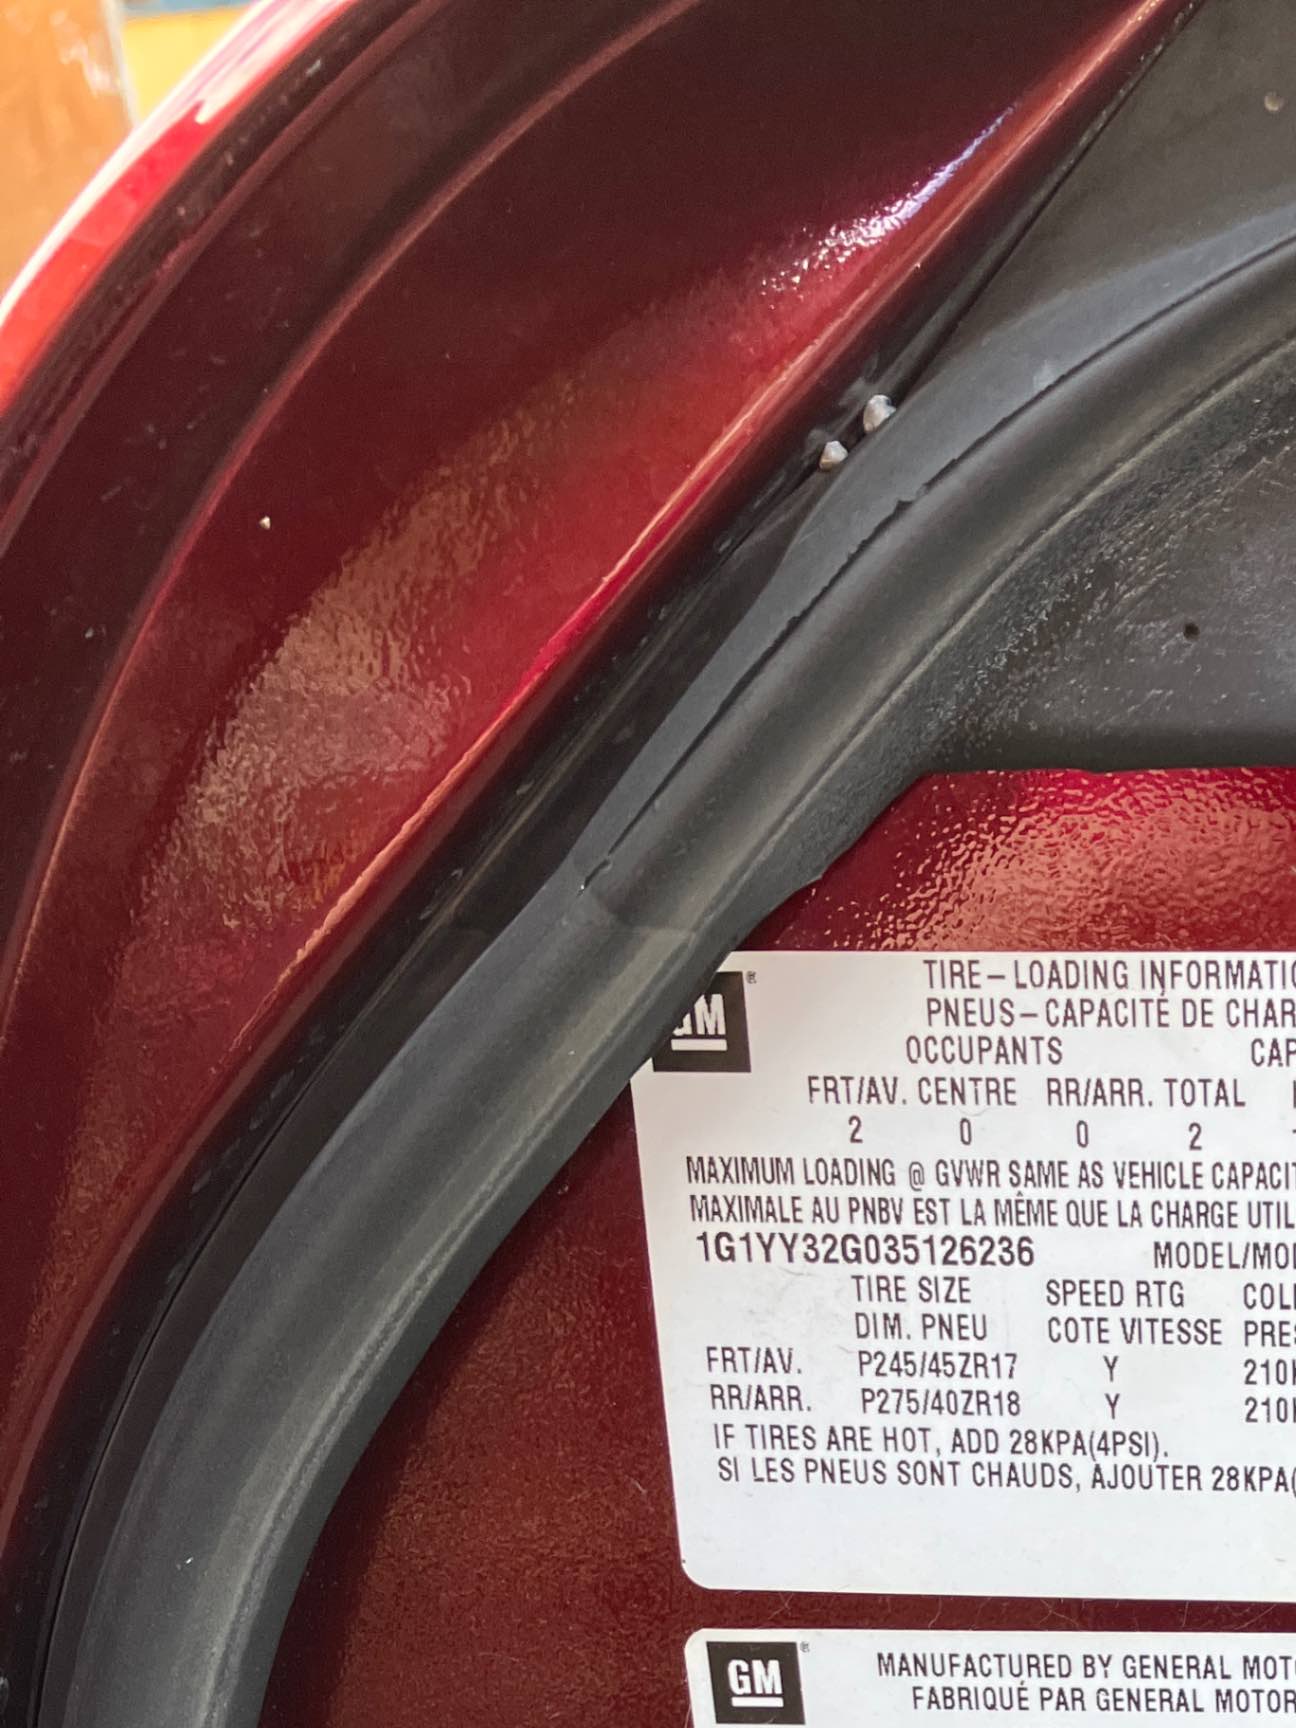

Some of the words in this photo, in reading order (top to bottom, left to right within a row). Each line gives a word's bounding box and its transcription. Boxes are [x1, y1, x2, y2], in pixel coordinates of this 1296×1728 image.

[1182, 998, 1213, 1027] DE
[906, 1035, 1062, 1064] OCCUPANTS
[808, 1075, 906, 1105] FRT/AV.
[918, 1076, 1017, 1105] CENTRE
[1048, 1077, 1153, 1107] RR/ARR.
[1164, 1078, 1246, 1107] TOTAL
[848, 1115, 863, 1143] 2
[959, 1118, 972, 1145] 0
[1076, 1120, 1089, 1147] 0
[1189, 1123, 1202, 1151] 2
[686, 1156, 794, 1184] MAXIMUM
[804, 1157, 895, 1186] LOADING
[909, 1162, 925, 1190] @
[936, 1159, 1000, 1187] GVWR
[1009, 1159, 1067, 1188] SAME
[1078, 1160, 1103, 1189] AS
[1115, 1162, 1203, 1190] VEHICLE
[690, 1195, 803, 1223] MAXIMALE
[812, 1196, 839, 1225] AU
[849, 1197, 903, 1225] PNBV
[914, 1197, 951, 1226] EST
[961, 1198, 985, 1227] LA
[995, 1190, 1058, 1227] MÊME
[1067, 1199, 1108, 1228] QUE
[1117, 1202, 1142, 1228] LA
[1152, 1201, 1238, 1229] CHARGE
[697, 1232, 1035, 1266] 1G1YY32G035126236
[851, 1276, 906, 1302] TIRE
[919, 1277, 971, 1303] SIZE
[1046, 1279, 1124, 1307] SPEED
[1136, 1281, 1184, 1308] RTG
[855, 1313, 911, 1340] DIM.
[922, 1314, 987, 1341] PNEU
[1048, 1317, 1110, 1345] COTE
[1121, 1318, 1223, 1346] VITESSE
[706, 1346, 802, 1374] FRT/AV.
[858, 1351, 1018, 1378] P245/45ZR17
[1104, 1355, 1119, 1382] Y
[711, 1384, 811, 1412] RR/ARR.
[862, 1388, 1021, 1416] P275/40ZR18
[1105, 1393, 1120, 1419] Y
[714, 1424, 735, 1449] IF
[745, 1425, 817, 1451] TIRES
[826, 1426, 872, 1453] ARE
[883, 1427, 941, 1458] HOT,
[951, 1427, 999, 1455] ADD
[1009, 1428, 1168, 1463] 28KPA(4PSI).
[718, 1458, 738, 1482] SI
[753, 1458, 794, 1484] LES
[805, 1459, 887, 1485] PNEUS
[898, 1461, 961, 1486] SONT
[973, 1462, 1080, 1493] CHAUDS,
[1091, 1463, 1202, 1492] AJOUTER
[728, 1658, 783, 1696] GM
[877, 1653, 1072, 1679] MANUFACTURED
[1083, 1655, 1113, 1679] BY
[1122, 1655, 1231, 1680] GENERAL
[912, 1680, 1028, 1712] FABRIQUÉ
[1040, 1687, 1086, 1712] PAR
[1096, 1687, 1205, 1713] GENERAL
